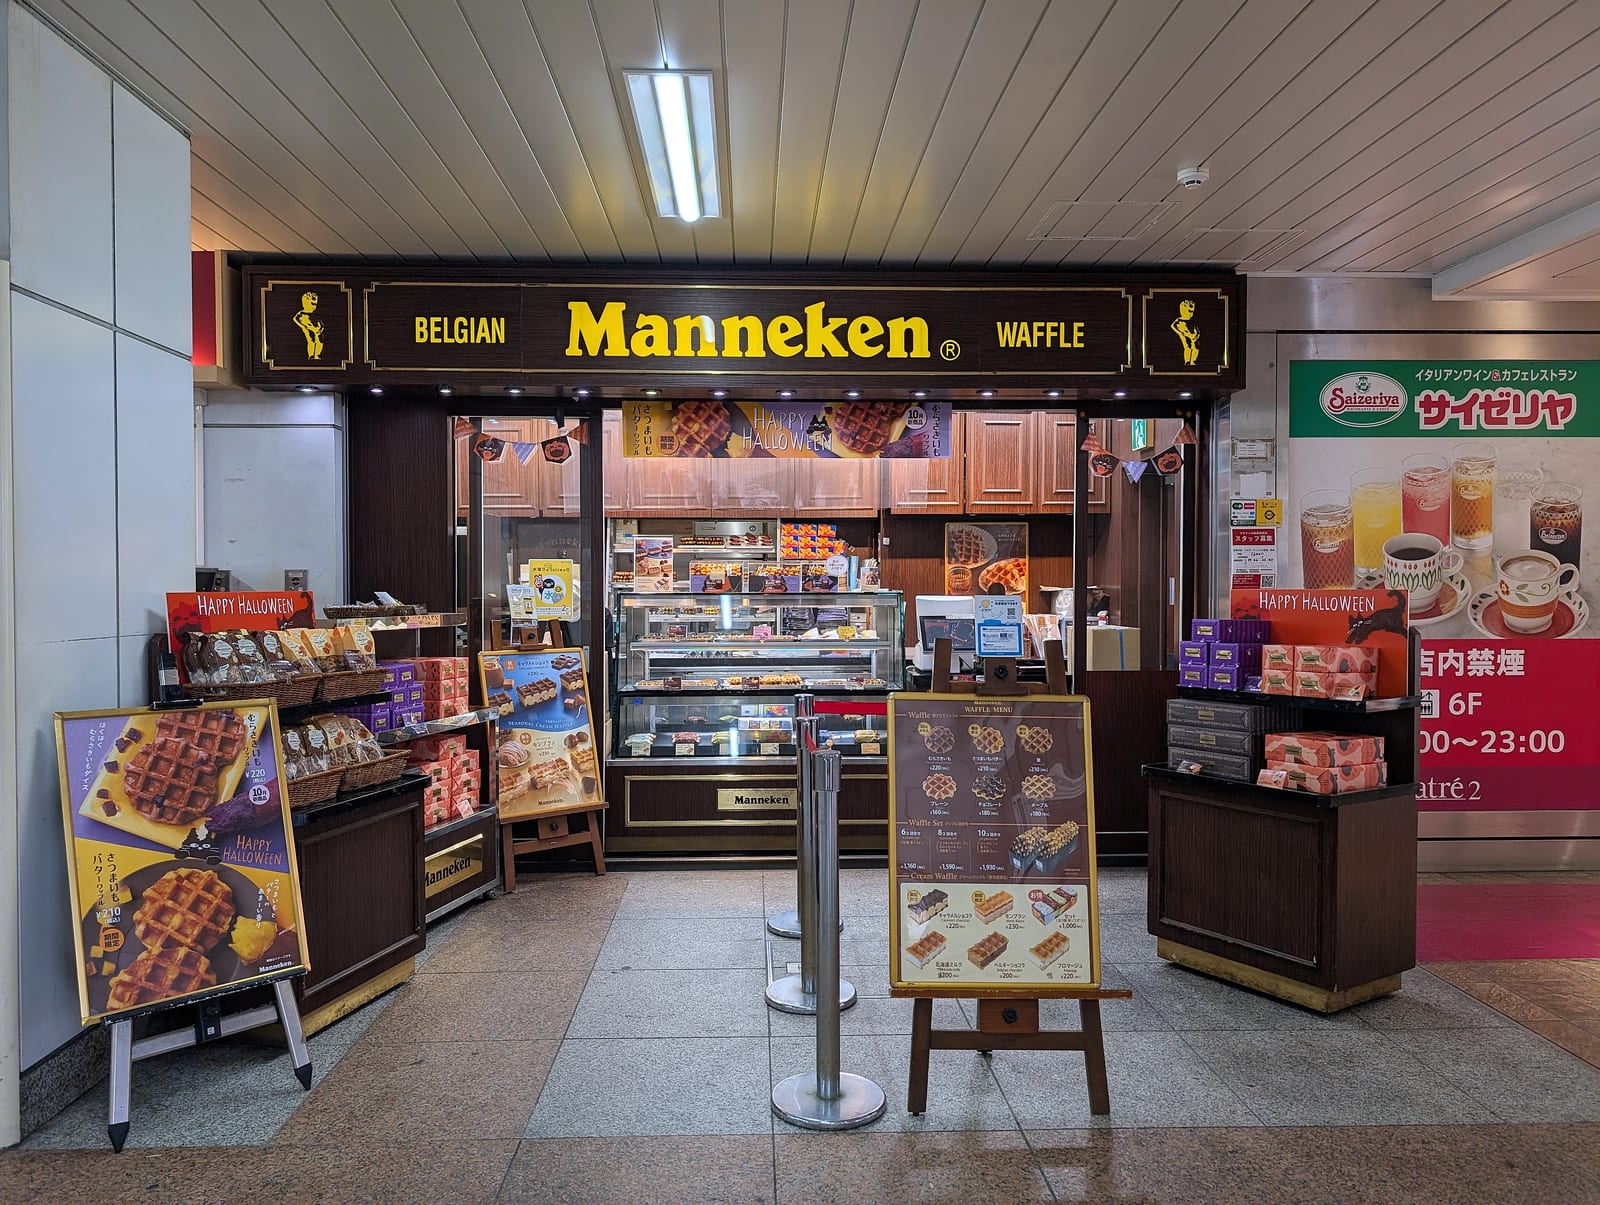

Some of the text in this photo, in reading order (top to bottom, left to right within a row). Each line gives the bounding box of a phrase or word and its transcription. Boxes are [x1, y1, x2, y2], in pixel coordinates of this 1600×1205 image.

[415, 316, 505, 344] BELGIAN
[565, 301, 931, 358] Manneken
[996, 321, 1085, 349] WAFFLE
[1328, 387, 1400, 412] Saizeriya
[1417, 389, 1575, 427] サイゼリヤ
[632, 404, 642, 456] バターワッフル
[643, 404, 652, 456] さつまいも
[753, 407, 808, 430] HAPPY
[742, 426, 833, 451] HALLOWEEN
[197, 594, 294, 617] HAPPY HALLOWEEN
[1259, 591, 1375, 612] HAPPY HALLOWEEN
[908, 711, 931, 719] Waffle
[1448, 692, 1483, 716] 6F
[245, 768, 266, 778] ¥220
[734, 795, 789, 805] Manneken
[1468, 780, 1482, 800] 2
[236, 834, 273, 852] HAPPY
[222, 846, 282, 865] HALLOWEEN
[92, 852, 105, 906] バターワッフル
[107, 852, 120, 903] さつまいも
[910, 873, 933, 881] Cream
[96, 906, 121, 919] ¥210
[259, 960, 293, 974] Manneken
